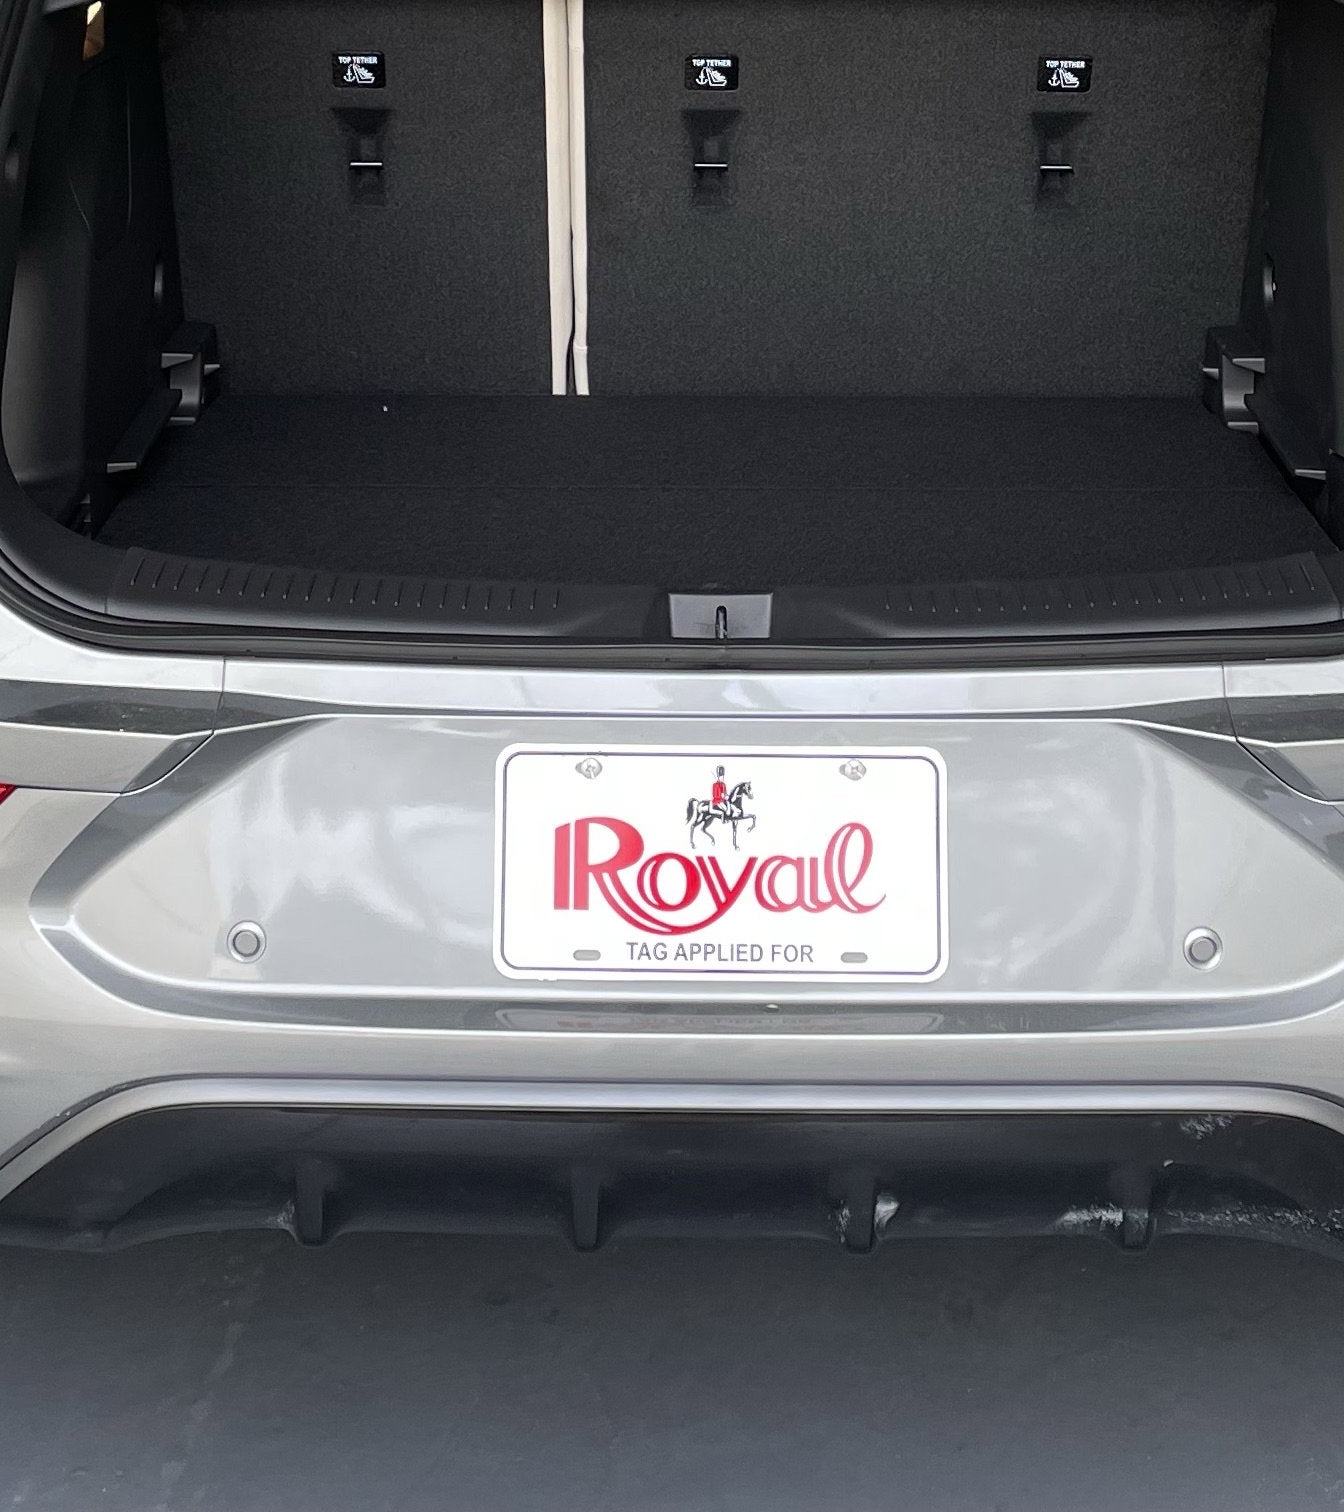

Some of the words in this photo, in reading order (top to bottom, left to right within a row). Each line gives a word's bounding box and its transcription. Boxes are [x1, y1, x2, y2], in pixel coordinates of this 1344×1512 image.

[554, 816, 887, 936] Royal
[626, 941, 668, 961] TAG
[674, 942, 764, 962] APPLIED
[771, 944, 814, 963] FOR
